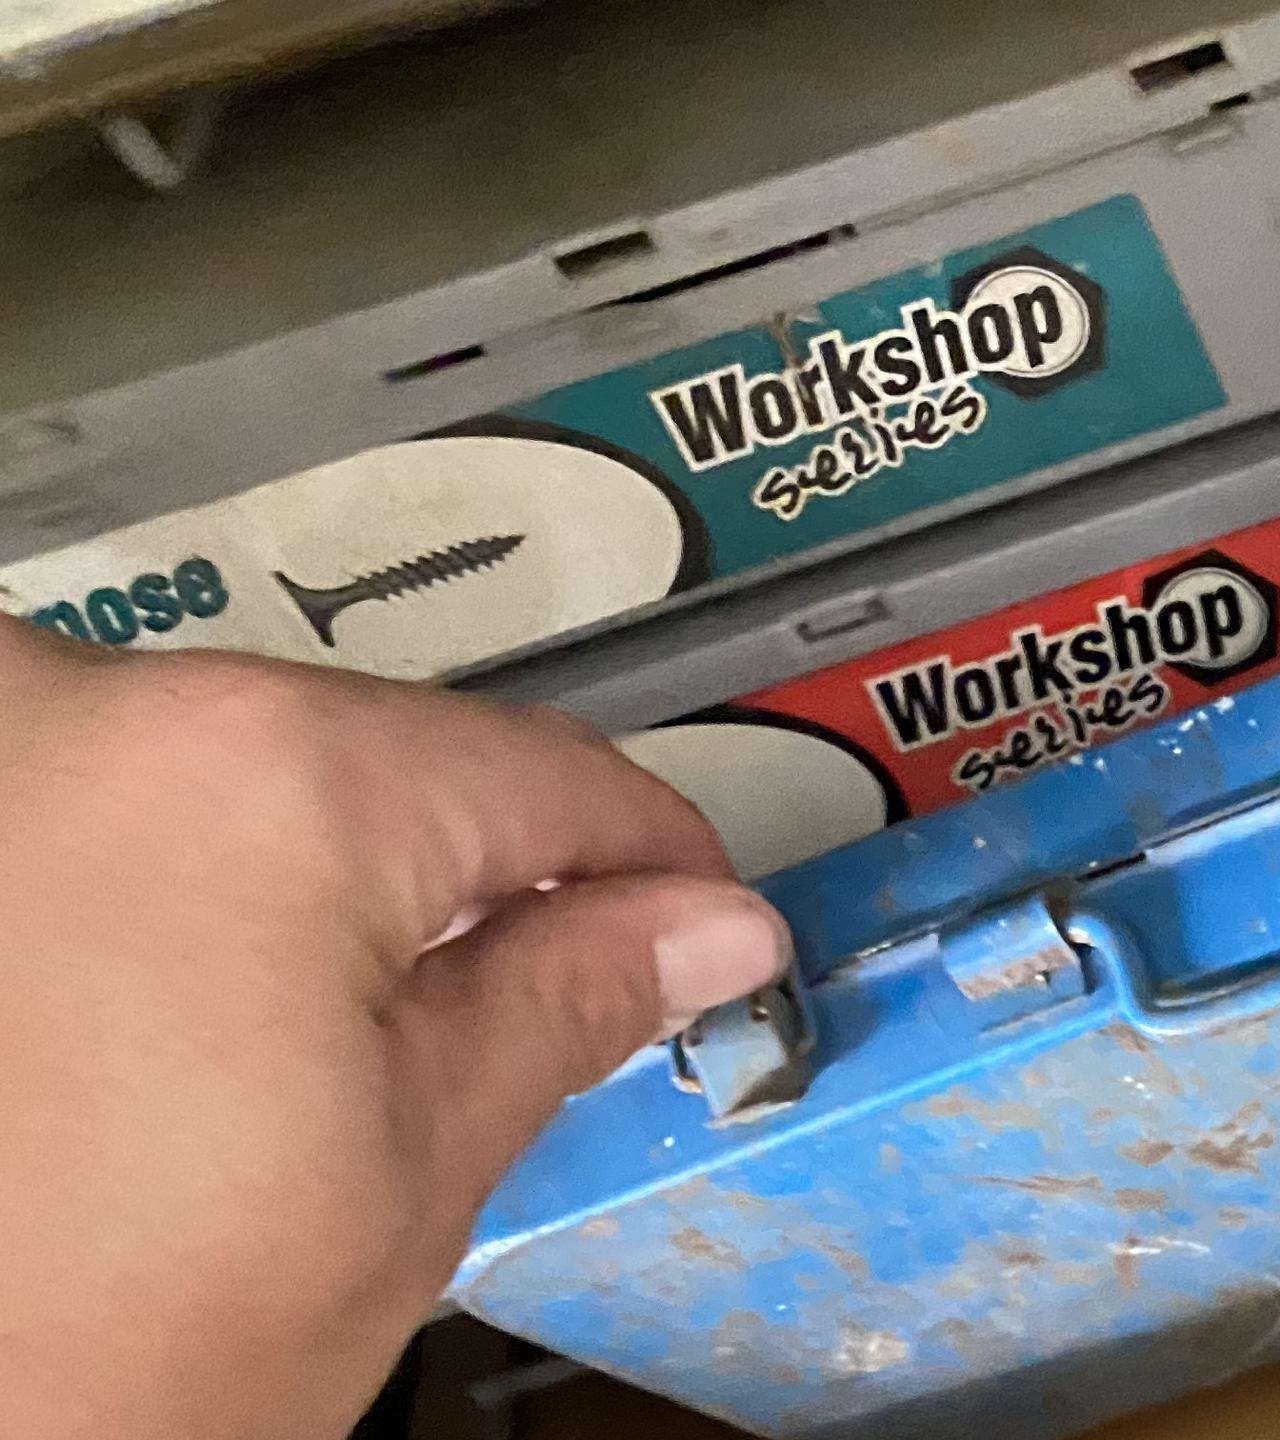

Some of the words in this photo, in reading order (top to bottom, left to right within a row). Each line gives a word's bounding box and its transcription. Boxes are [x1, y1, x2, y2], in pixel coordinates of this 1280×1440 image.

[655, 282, 1063, 468] Workshop
[757, 384, 984, 514] series
[873, 580, 1245, 747] Workshop
[957, 673, 1168, 789] series
